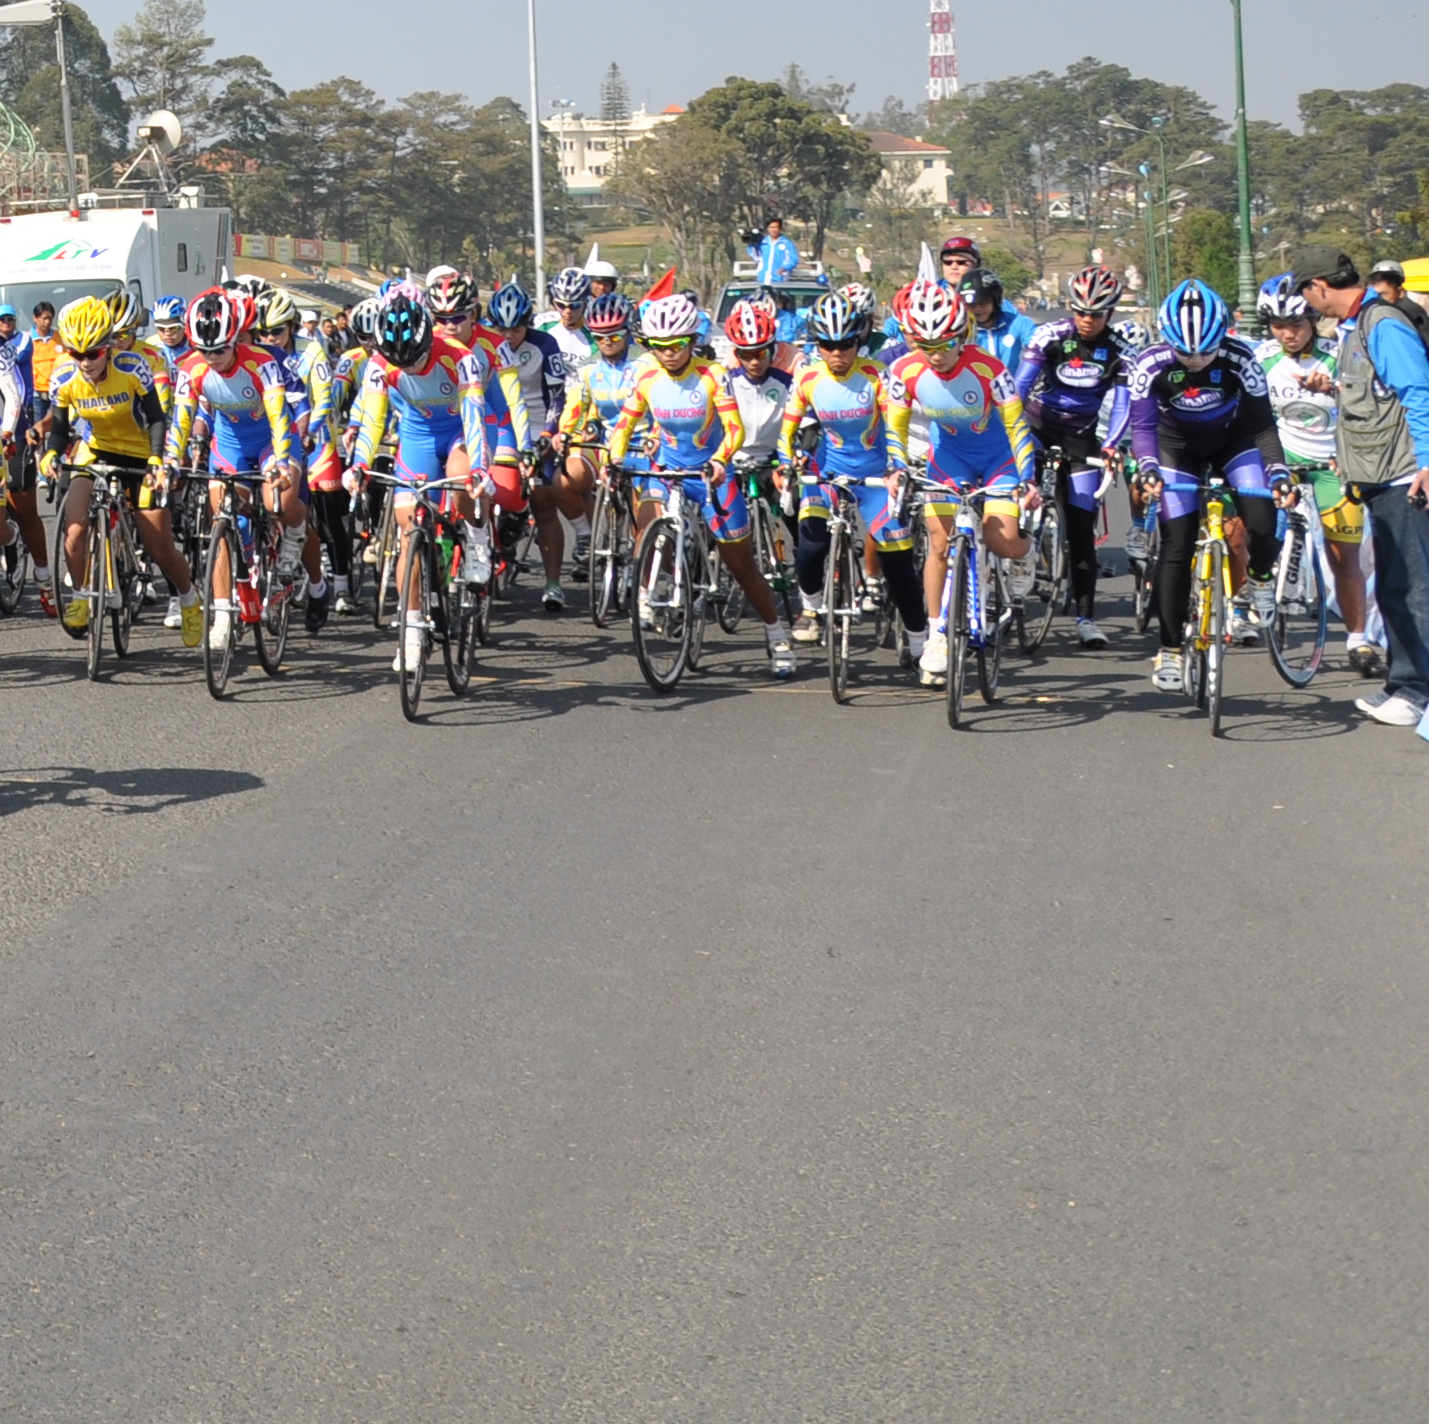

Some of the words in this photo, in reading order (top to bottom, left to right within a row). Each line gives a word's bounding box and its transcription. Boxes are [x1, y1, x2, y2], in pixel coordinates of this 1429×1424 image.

[261, 362, 283, 385] 12
[459, 357, 479, 381] 14
[993, 376, 1016, 400] 15
[77, 391, 130, 409] THAILAND
